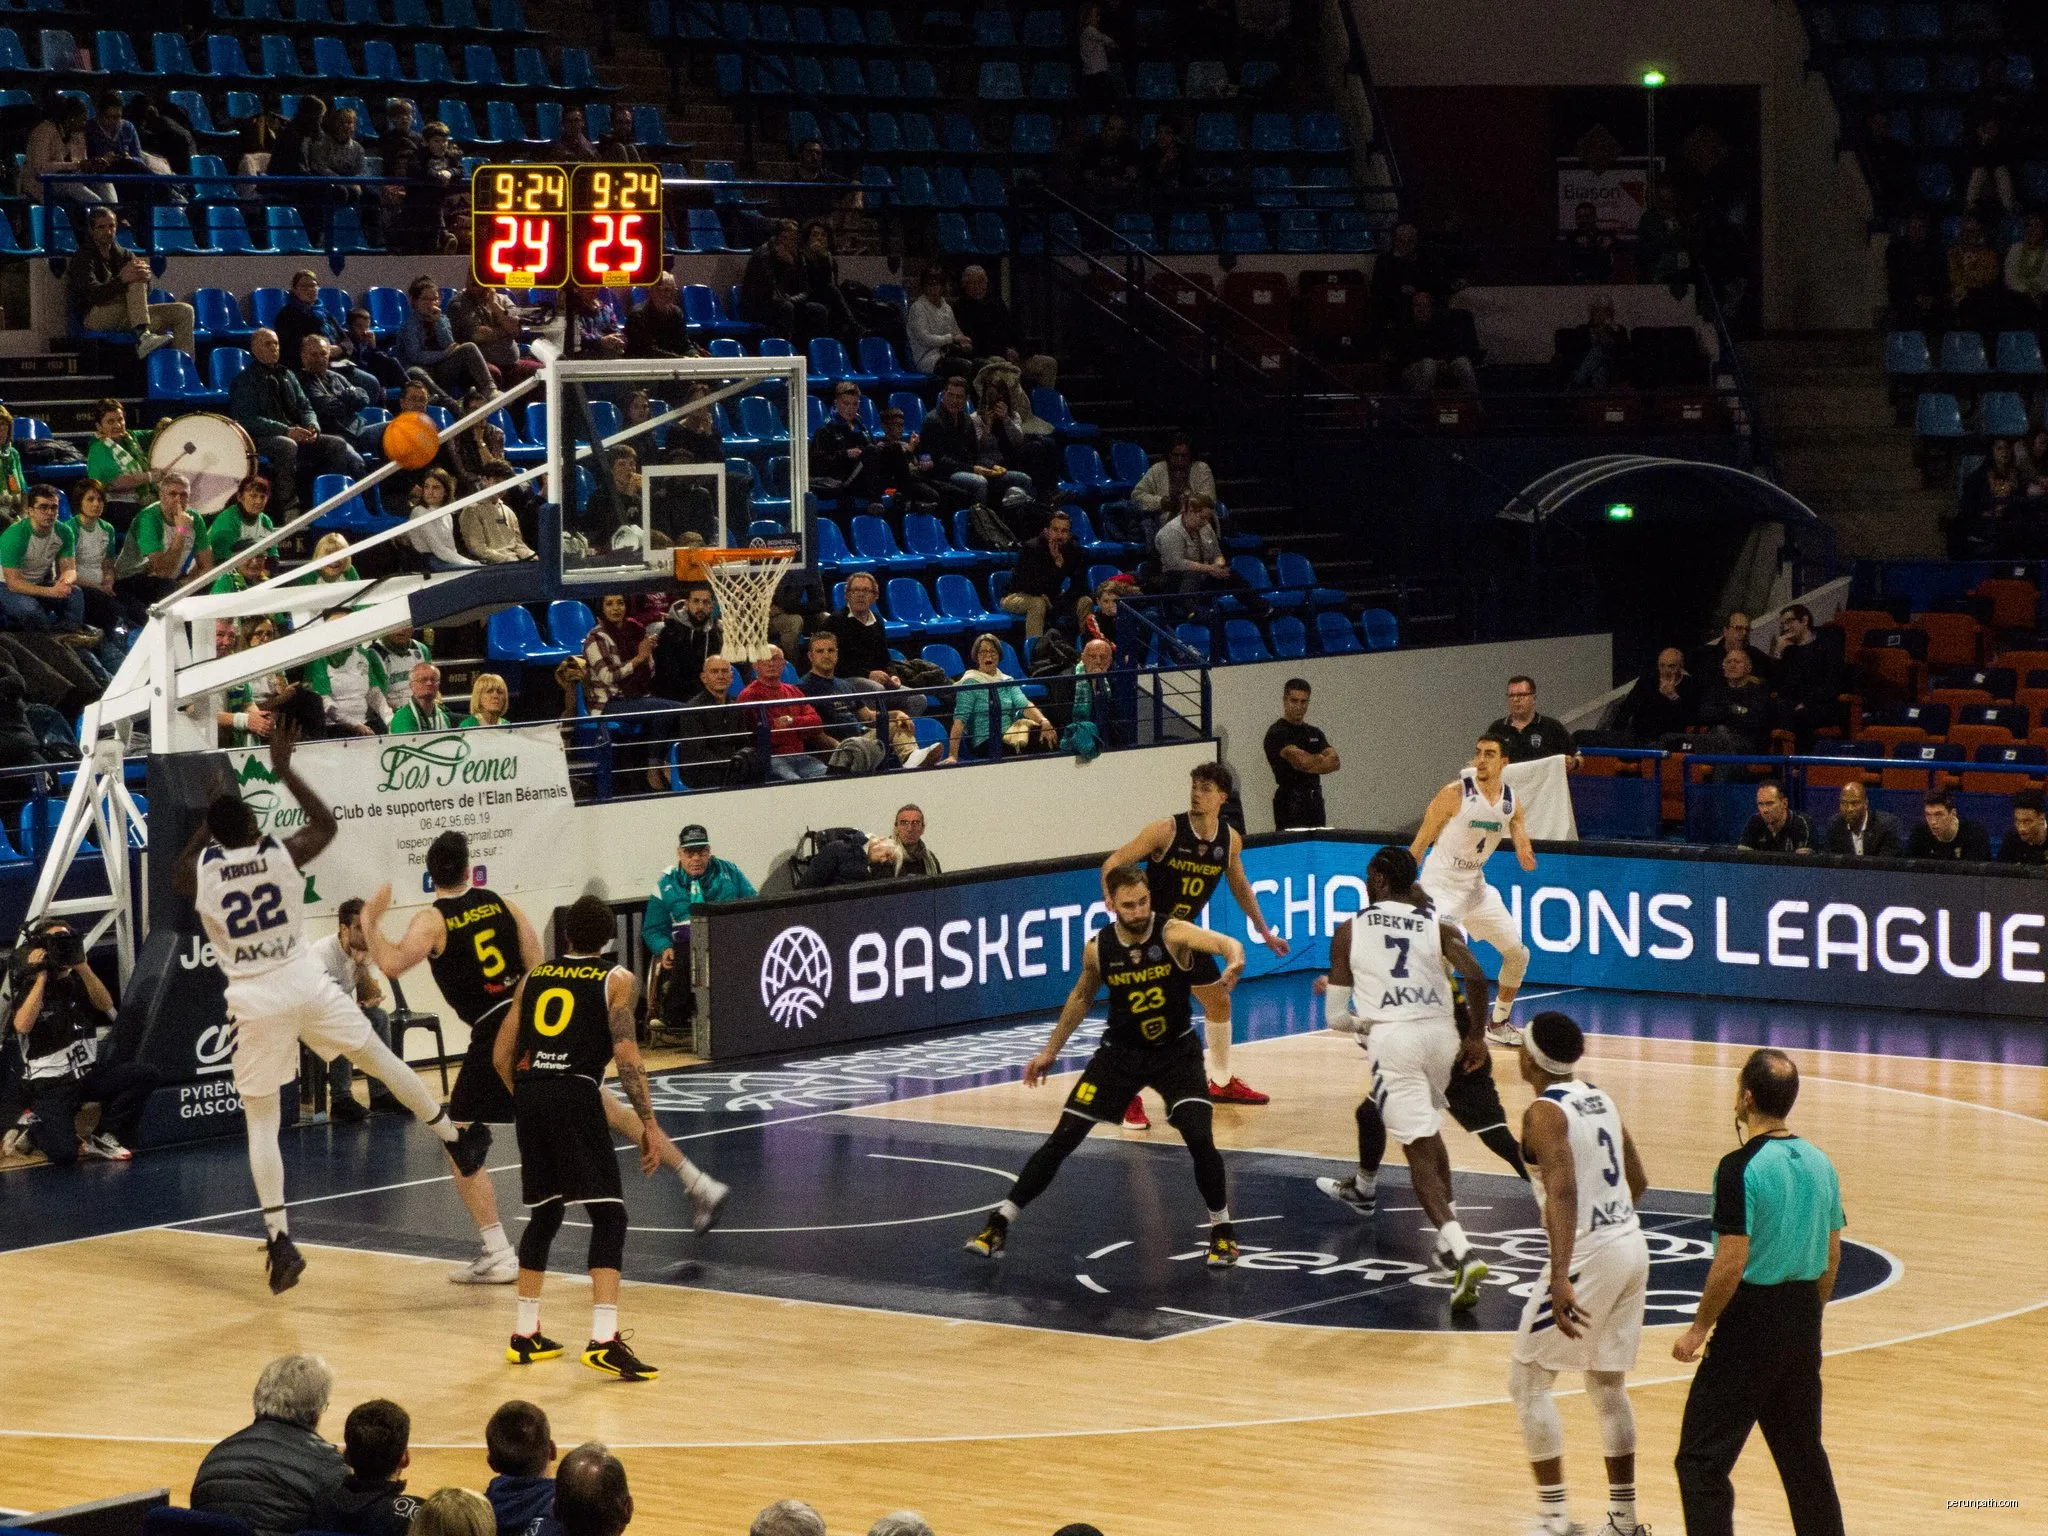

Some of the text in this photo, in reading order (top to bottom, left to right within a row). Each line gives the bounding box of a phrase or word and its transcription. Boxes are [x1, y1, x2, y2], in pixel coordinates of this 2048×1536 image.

[496, 173, 564, 210] 9:24
[593, 172, 658, 209] 9:24
[587, 215, 643, 273] 25
[377, 744, 430, 792] Los
[333, 784, 568, 820] Club de supporters de l'Elan Béarnais
[420, 812, 491, 830] 06.42.95.69.19
[1476, 836, 1487, 853] 4
[1167, 857, 1222, 877] ANTWERP
[1180, 877, 1205, 897] 10
[221, 882, 288, 939] 22
[446, 903, 503, 930] KLASSEN
[1367, 912, 1425, 933] IBEKWE
[473, 928, 506, 978] 5
[1384, 934, 1411, 979] 7
[1712, 895, 2047, 984] LEAGUE
[530, 965, 608, 981] BRANCH
[1108, 963, 1173, 986] ANTWERP
[533, 987, 575, 1037] 0
[1128, 987, 1167, 1014] 23
[536, 1050, 569, 1060] Port of
[1597, 1127, 1620, 1187] 3
